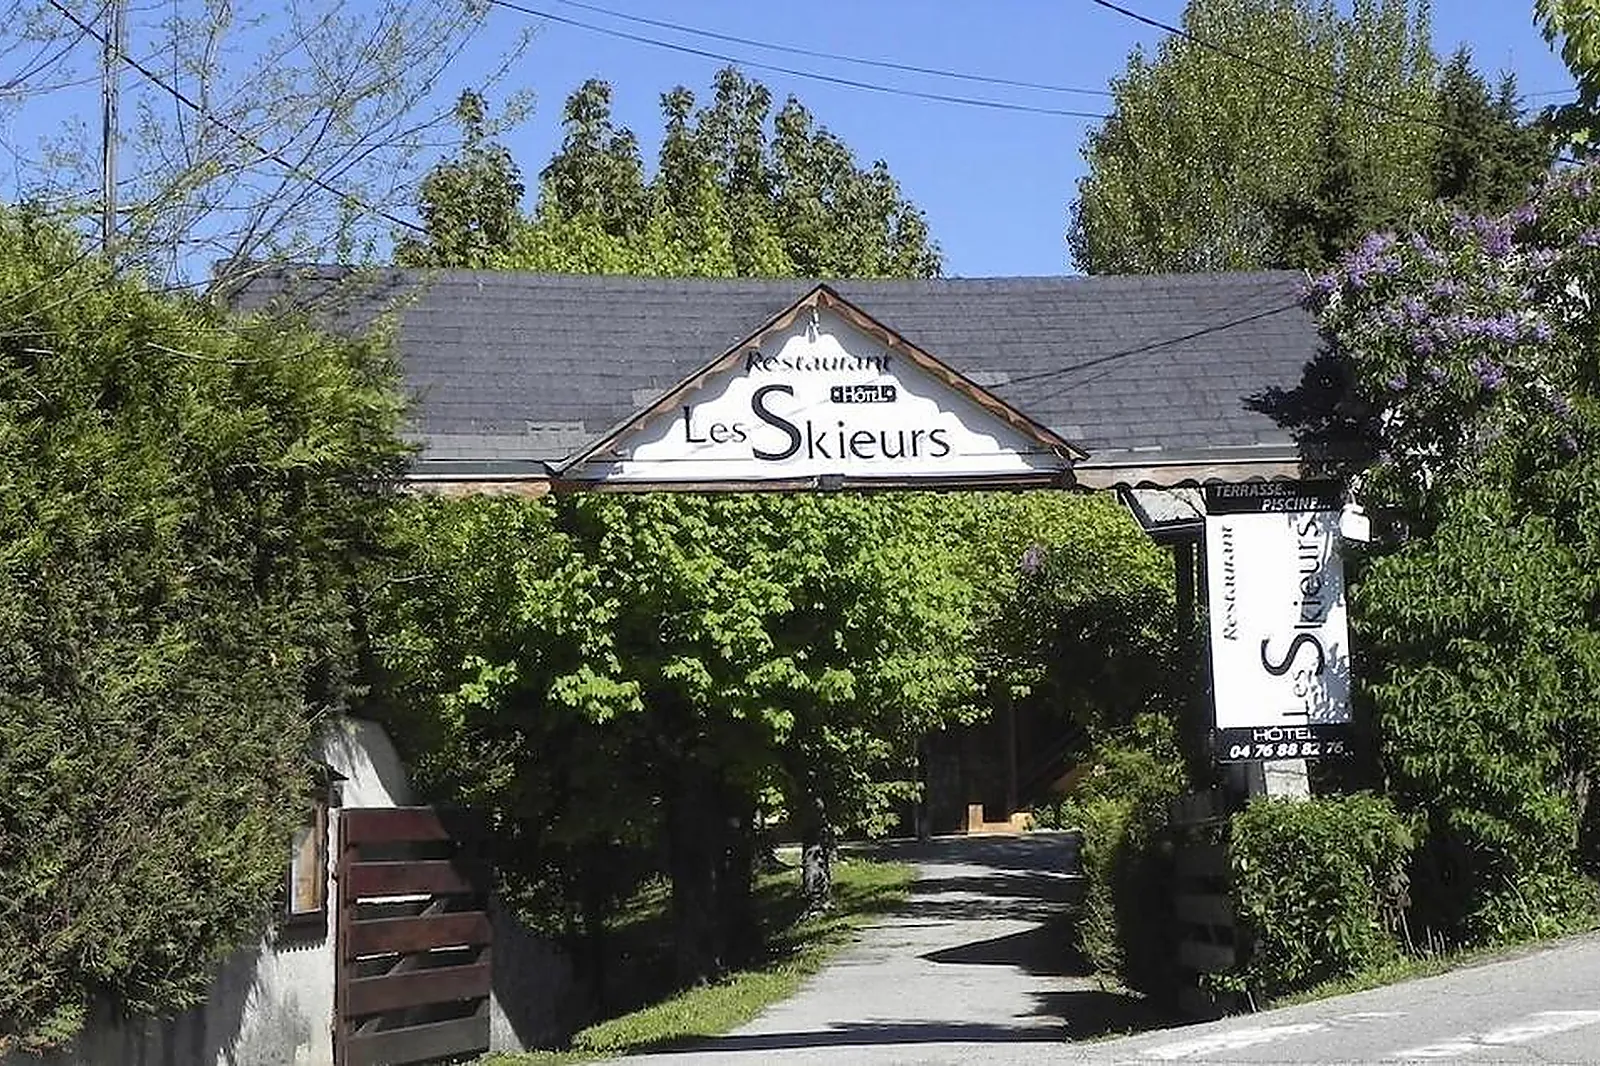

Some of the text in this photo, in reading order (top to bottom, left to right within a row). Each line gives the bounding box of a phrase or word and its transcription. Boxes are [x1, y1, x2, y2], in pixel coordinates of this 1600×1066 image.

[746, 350, 893, 374] Restaurant
[683, 384, 951, 461] Les Skieurs
[1222, 524, 1237, 641] Restaurant
[1260, 512, 1325, 676] Skieurs
[1229, 740, 1344, 758] 04 76 88 82 76
